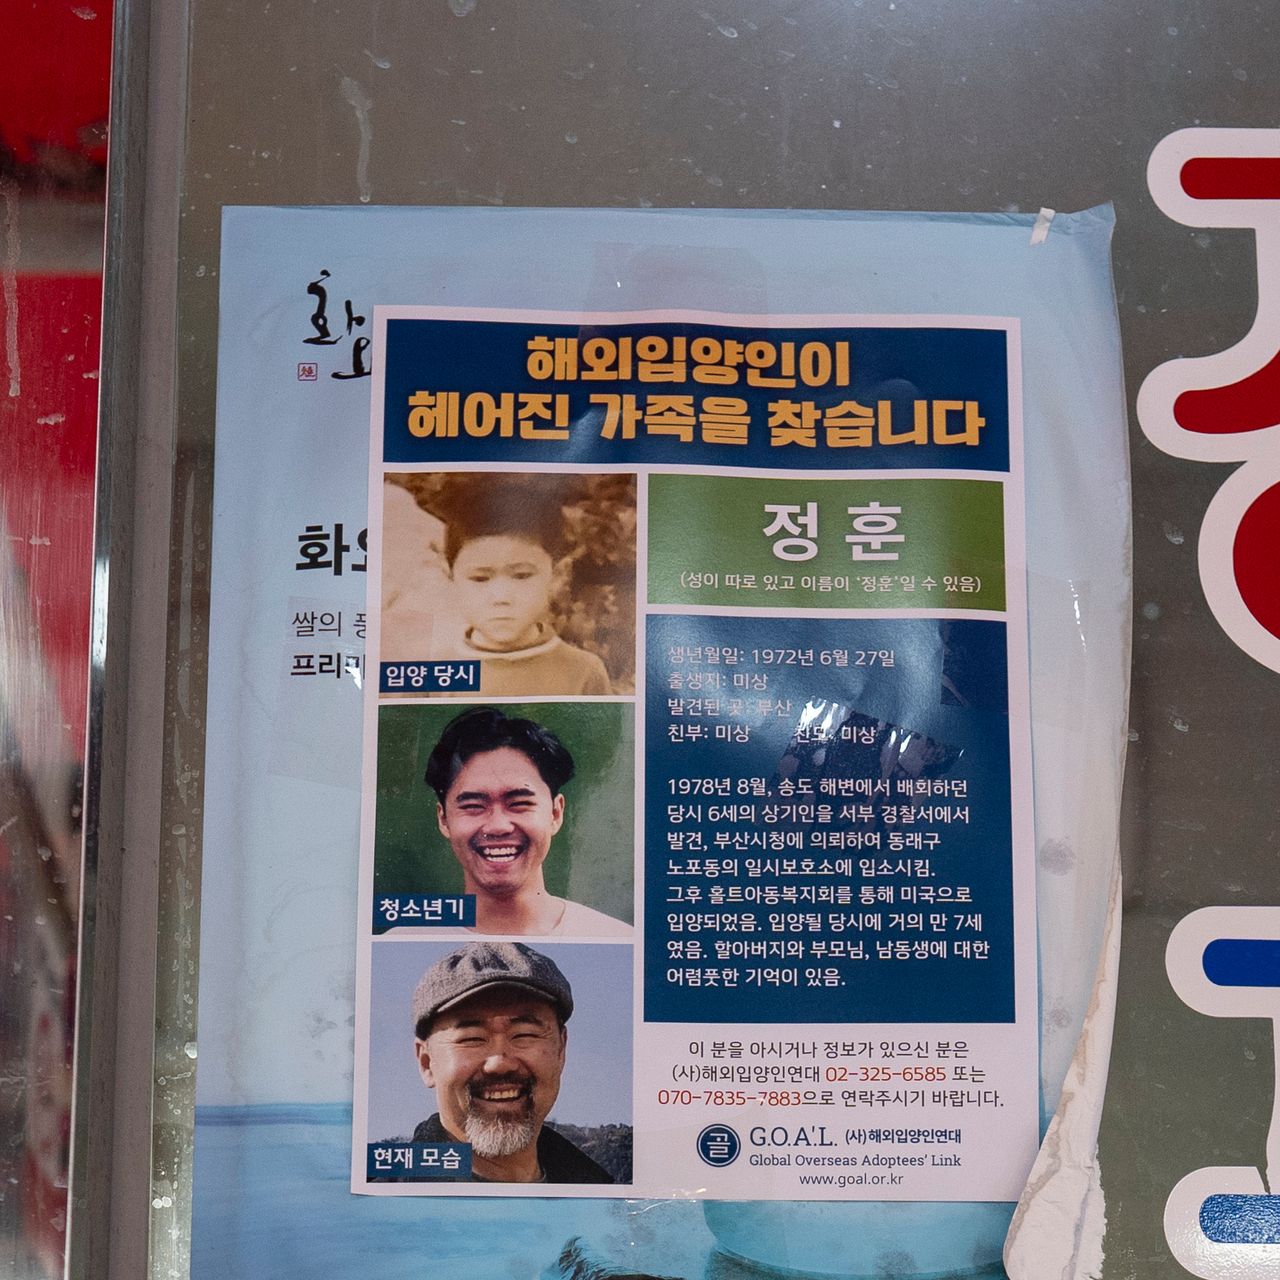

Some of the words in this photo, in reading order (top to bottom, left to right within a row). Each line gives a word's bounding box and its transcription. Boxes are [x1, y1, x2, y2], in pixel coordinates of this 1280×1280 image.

[526, 335, 848, 388] 해외입양인이
[407, 389, 572, 442] 헤어진
[598, 393, 752, 445] 가족을
[768, 398, 986, 448] 찾습니다
[680, 571, 719, 589] (성이
[725, 573, 756, 589] 따로
[763, 575, 796, 591] 있고
[801, 575, 850, 591] 이름이
[922, 576, 937, 591] 수
[943, 576, 981, 593] 있음)
[292, 611, 341, 637] 쌀의
[668, 646, 744, 664] 생년월일:
[752, 649, 813, 666] 1972년
[820, 649, 849, 667] 6월
[855, 650, 895, 667] 27일
[385, 665, 427, 687] 입양
[434, 664, 474, 685] 당시
[668, 671, 726, 690] 출생지:
[733, 673, 769, 690] 미상
[668, 698, 720, 716] 발견된
[668, 724, 709, 742] 친부:
[715, 724, 751, 742] 미상
[841, 726, 877, 744] 미상
[667, 778, 731, 796] 1978년
[737, 778, 772, 797] 8월,
[778, 778, 814, 796] 송도
[819, 779, 891, 797] 해변에서
[897, 779, 968, 797] 배회하던
[667, 805, 701, 823] 당시
[708, 805, 755, 823] 6세의
[761, 806, 833, 823] 상기인을
[839, 806, 875, 824] 서부
[881, 807, 969, 824] 경찰서에서
[667, 832, 708, 851] 발견,
[714, 832, 803, 850] 부산시청에
[810, 832, 881, 850] 의뢰하여
[887, 832, 941, 851] 동래구
[667, 859, 738, 877] 노포동의
[745, 859, 853, 877] 일시보호소에
[859, 859, 936, 877] 입소시킴.
[667, 886, 702, 904] 그후
[708, 886, 853, 905] 홀트아동복지회를
[859, 887, 894, 904] 통해
[901, 886, 973, 904] 미국으로
[379, 899, 464, 920] 청소년기
[667, 913, 762, 932] 입양되었음.
[769, 913, 821, 932] 입양될
[828, 913, 882, 932] 당시에
[889, 913, 922, 932] 거의
[929, 914, 948, 932] 만
[954, 914, 983, 931] 7세
[667, 941, 707, 959] 였음.
[714, 941, 804, 959] 할아버지와
[810, 941, 870, 960] 부모님,
[876, 941, 948, 960] 남동생에
[954, 941, 990, 959] 대한
[667, 968, 739, 987] 어렴풋한
[746, 968, 798, 987] 기억이
[805, 968, 846, 987] 있음.
[689, 1041, 704, 1057] 이
[711, 1041, 744, 1057] 분을
[750, 1041, 818, 1058] 아시거나
[823, 1041, 874, 1058] 정보가
[880, 1041, 930, 1058] 있으신
[935, 1042, 969, 1058] 분은
[672, 1065, 820, 1083] (사)해외입양인연대
[825, 1066, 946, 1082] 02-325-6585
[952, 1066, 986, 1083] 또는
[658, 1089, 835, 1106] 070-7835-7883으로
[841, 1090, 926, 1107] 연락주시기
[931, 1090, 1004, 1108] 바랍니다.
[845, 1128, 962, 1146] (사)해외입양인연대
[374, 1148, 413, 1169] 현재
[420, 1148, 462, 1169] 모습
[749, 1154, 791, 1166] Global
[795, 1154, 857, 1167] Overseas
[931, 1154, 961, 1166] Link
[799, 1173, 903, 1187] www.goal.or.kr
